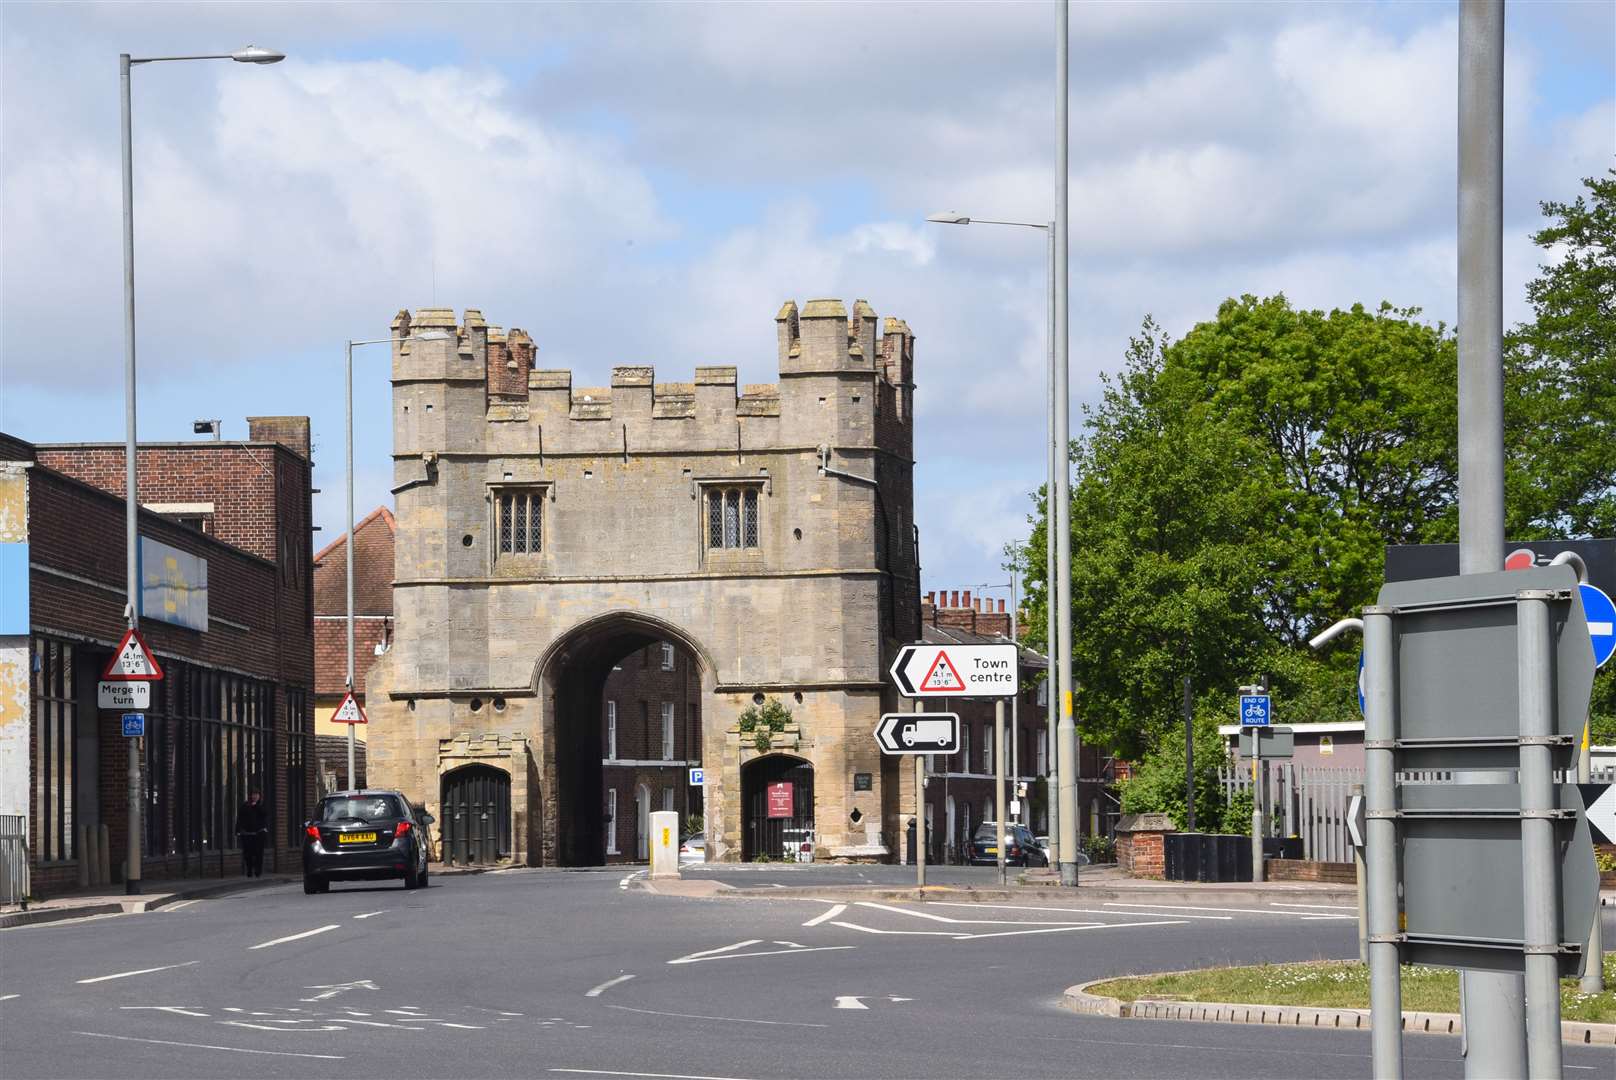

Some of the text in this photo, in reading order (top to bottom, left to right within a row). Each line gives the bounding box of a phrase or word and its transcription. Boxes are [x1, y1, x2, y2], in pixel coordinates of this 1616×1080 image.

[973, 658, 1008, 668] Town
[970, 672, 1012, 682] centre
[102, 685, 133, 695] Merge
[694, 772, 702, 782] P
